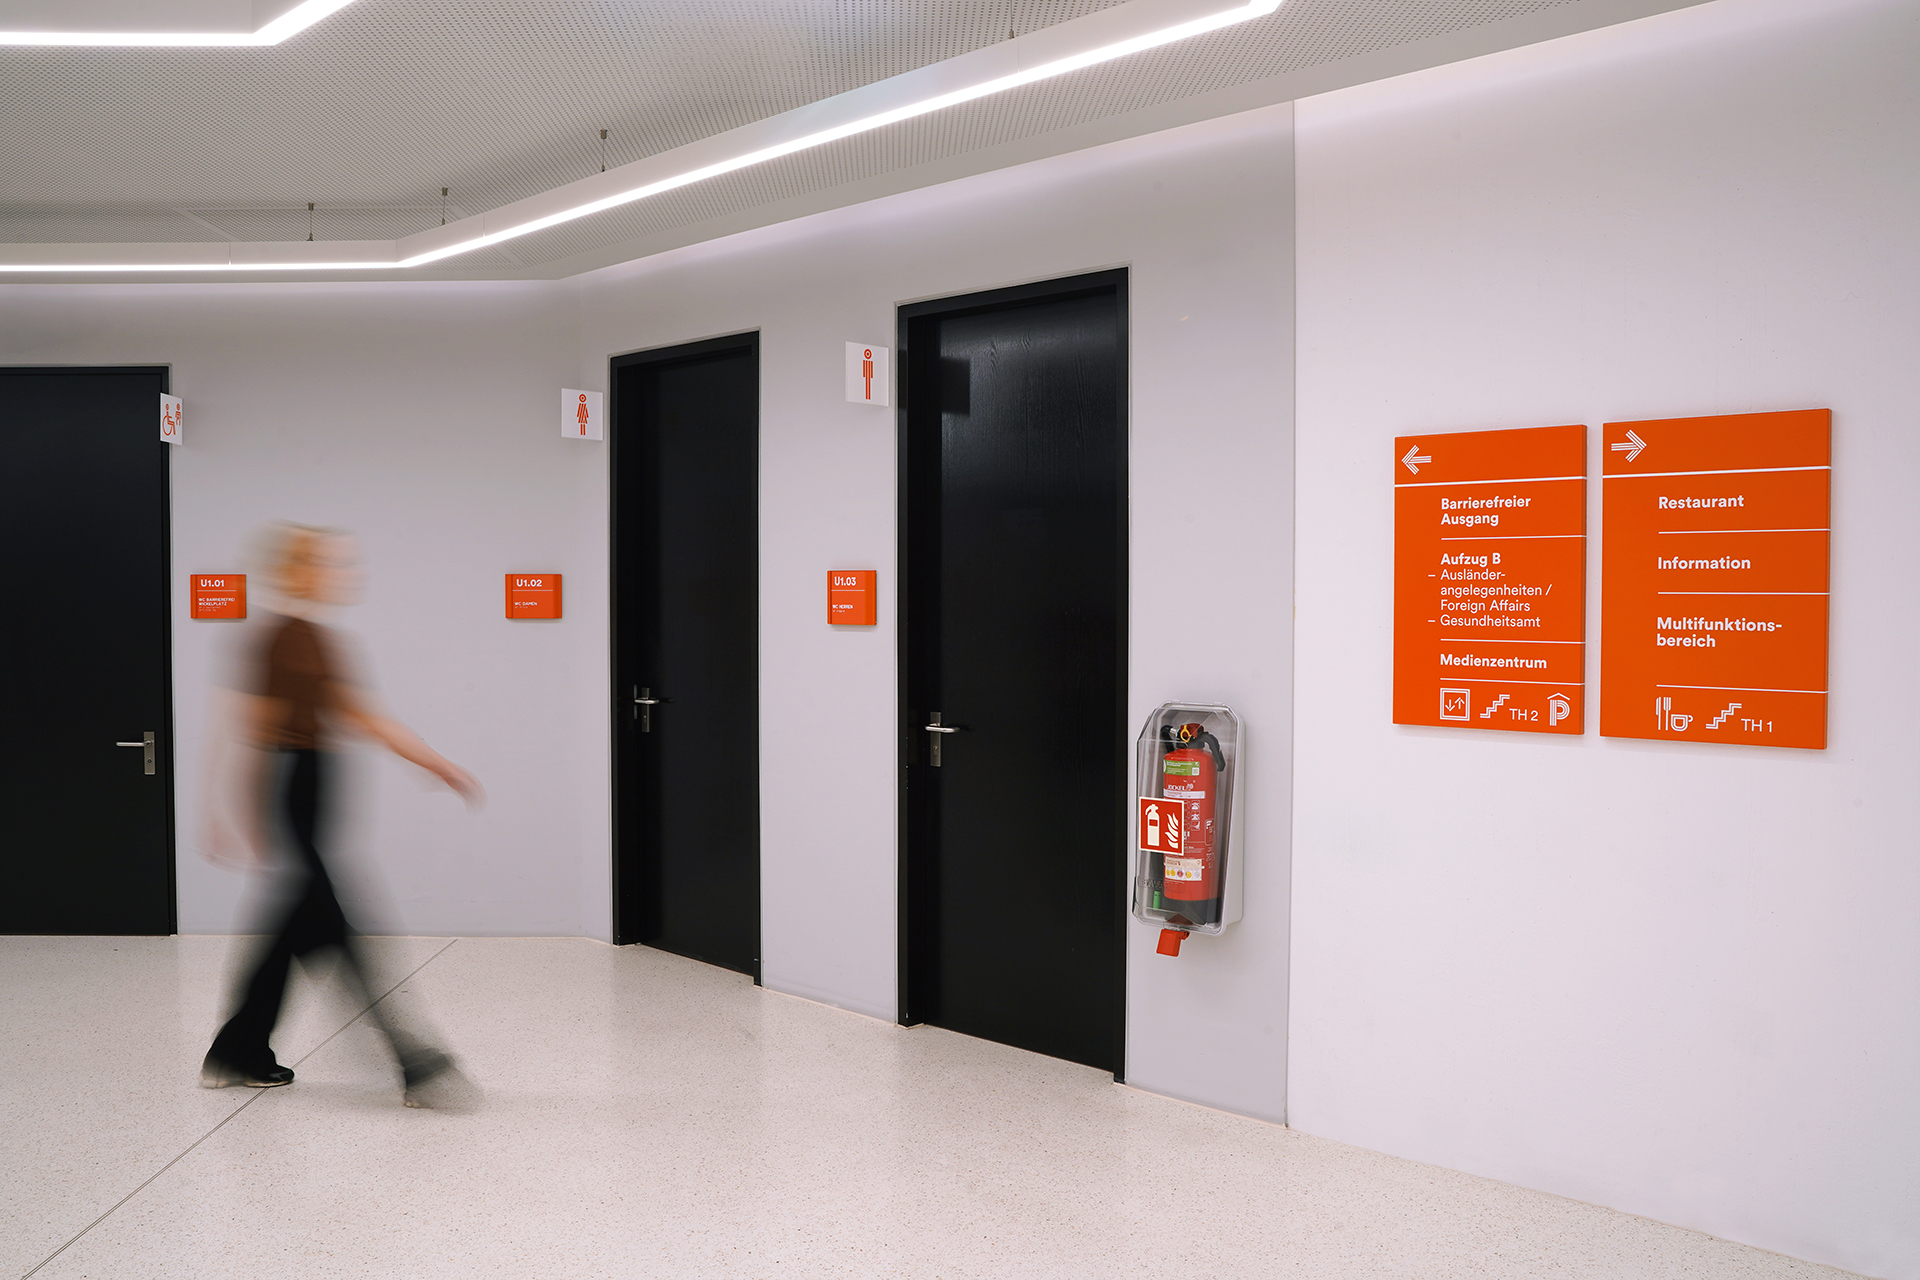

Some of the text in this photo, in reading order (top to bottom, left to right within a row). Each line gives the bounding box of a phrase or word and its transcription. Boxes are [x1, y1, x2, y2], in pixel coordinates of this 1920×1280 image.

[1441, 495, 1531, 510] Barrierefreier
[1658, 495, 1744, 509] Restaurant
[1441, 513, 1499, 527] Ausgang
[1441, 553, 1501, 567] Aufzug B
[1658, 556, 1751, 569] Information
[834, 576, 857, 586] U1.03
[1440, 569, 1506, 580] Ausländer-
[200, 579, 225, 587] U1.01
[516, 579, 542, 587] U1.02
[1440, 584, 1542, 598] angelegenheiten
[1440, 600, 1531, 613] Foreign Affairs
[1440, 615, 1541, 627] Gesundheitsamt
[1657, 617, 1782, 632] Multifunktions-
[1656, 633, 1716, 647] bereich
[1440, 654, 1547, 669] Medienzentrum
[1509, 708, 1539, 722] TH 2
[1741, 718, 1773, 733] TH 1
